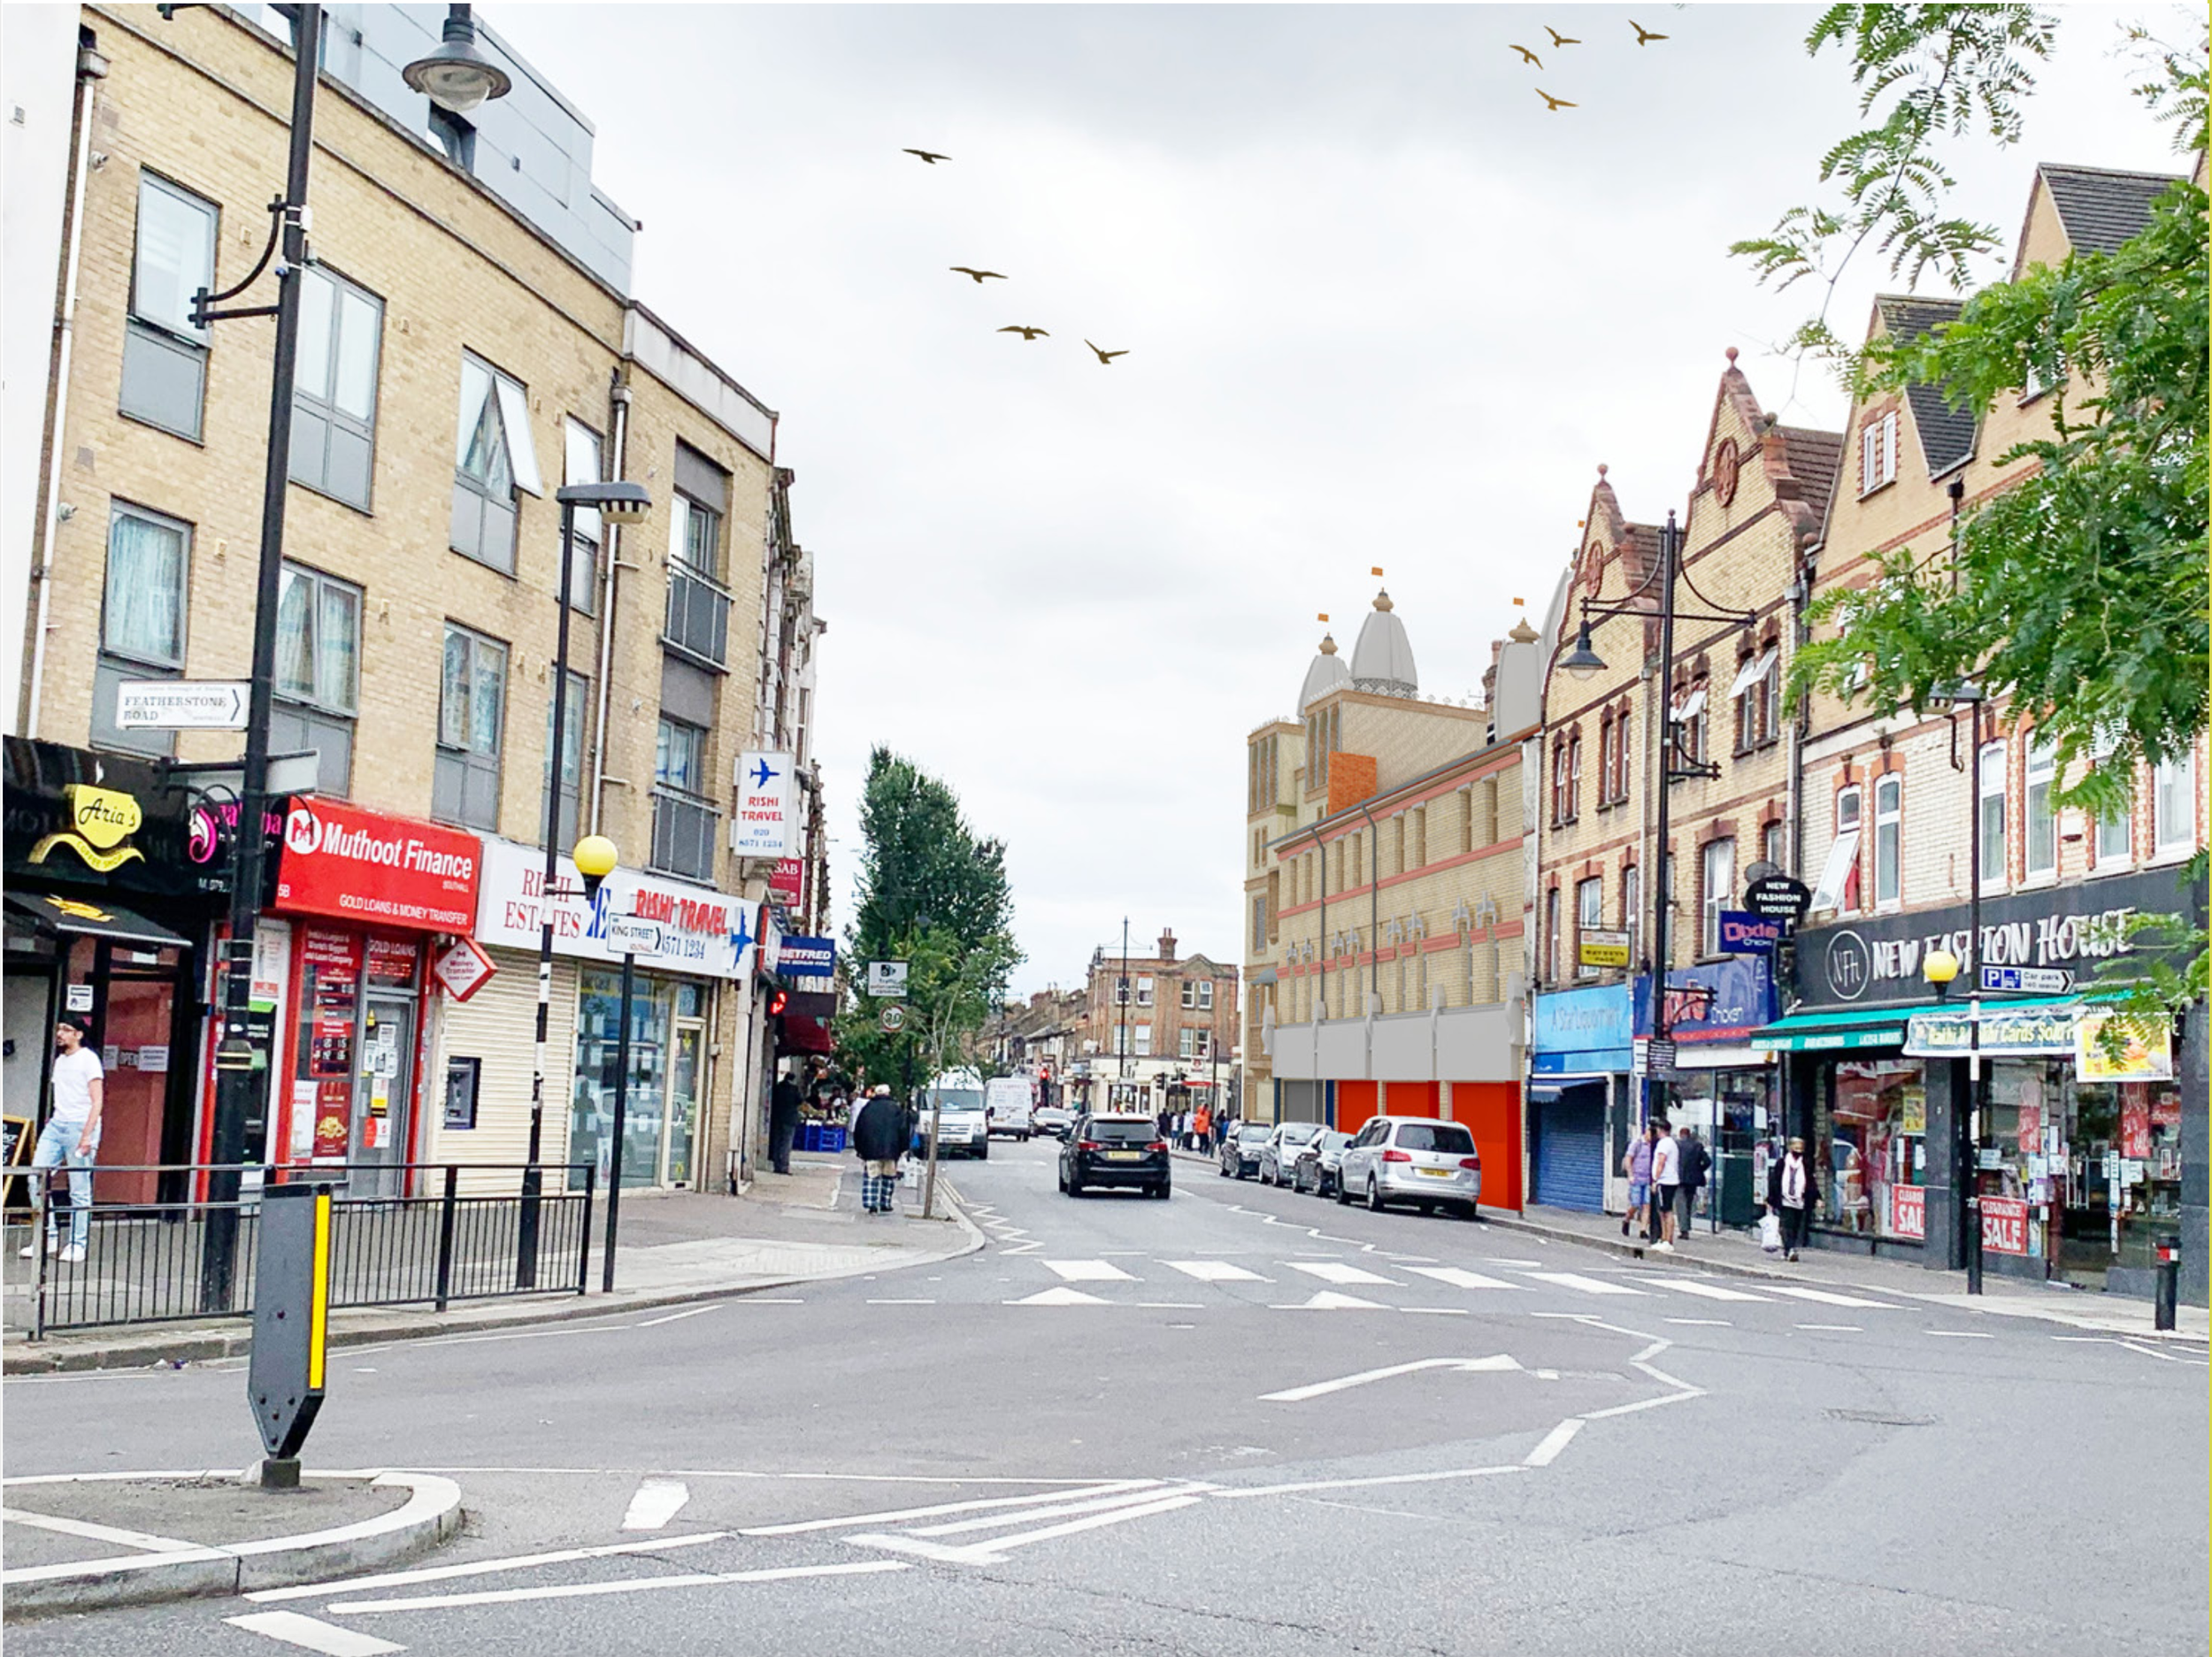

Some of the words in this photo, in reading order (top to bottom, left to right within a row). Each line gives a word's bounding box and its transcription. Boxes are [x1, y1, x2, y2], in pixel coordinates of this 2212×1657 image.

[124, 696, 227, 707] FEATHERSTONE
[123, 710, 158, 721] ROAD
[748, 796, 779, 807] RISHI
[741, 810, 784, 821] TRAVEL
[322, 821, 403, 868] Muthoot
[403, 840, 472, 880] Finance
[522, 868, 572, 903] RIHI
[1755, 893, 1801, 902] FASHION
[339, 894, 364, 910] GOLD
[364, 899, 392, 916] LOANS
[392, 902, 399, 916] &
[399, 904, 428, 920] MONEY
[428, 909, 469, 926] TRANSFER
[635, 888, 675, 924] RISHI
[679, 897, 728, 935] TRAVEL
[1760, 905, 1797, 914] HOUSE
[503, 901, 582, 940] ESTTES
[611, 925, 629, 937] KING
[630, 927, 654, 940] STREET
[663, 935, 681, 955] 571
[685, 939, 706, 960] 1234
[1871, 940, 1920, 981] NEW
[2036, 906, 2137, 966] HOUSE
[2041, 973, 2060, 982] park
[1981, 1201, 2023, 1217] CLEARANCE
[1982, 1216, 2022, 1251] SALE
